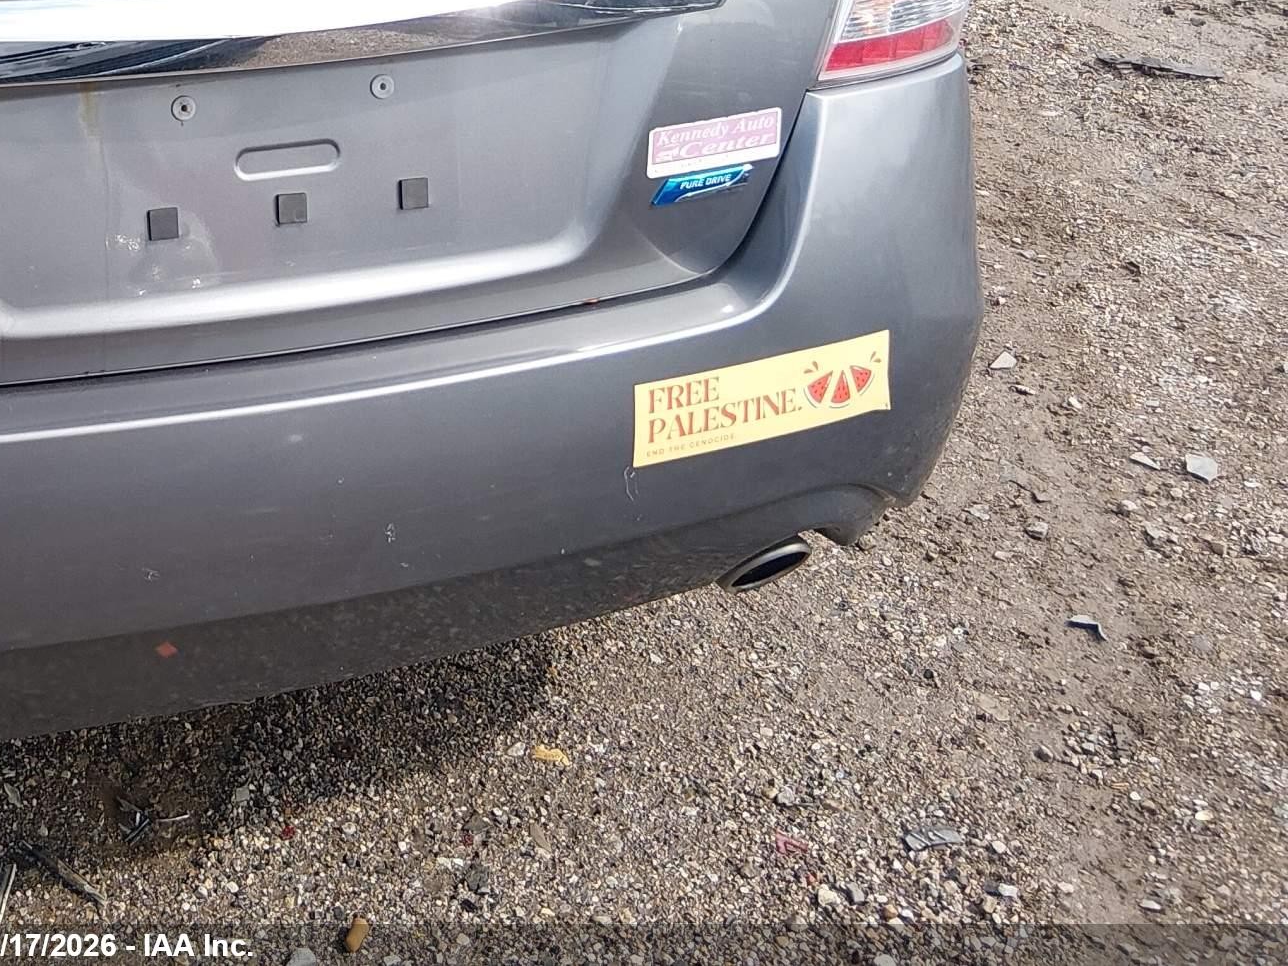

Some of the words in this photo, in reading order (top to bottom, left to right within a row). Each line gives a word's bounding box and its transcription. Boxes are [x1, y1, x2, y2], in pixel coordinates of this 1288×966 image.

[658, 121, 729, 147] Kennedy
[733, 115, 775, 134] Auto
[679, 133, 775, 158] Center
[680, 178, 704, 190] PURE
[705, 174, 732, 187] DRIVE
[648, 376, 720, 414] FREE
[648, 388, 803, 444] PALESTINE.
[646, 448, 665, 458] END
[669, 443, 686, 452] THE
